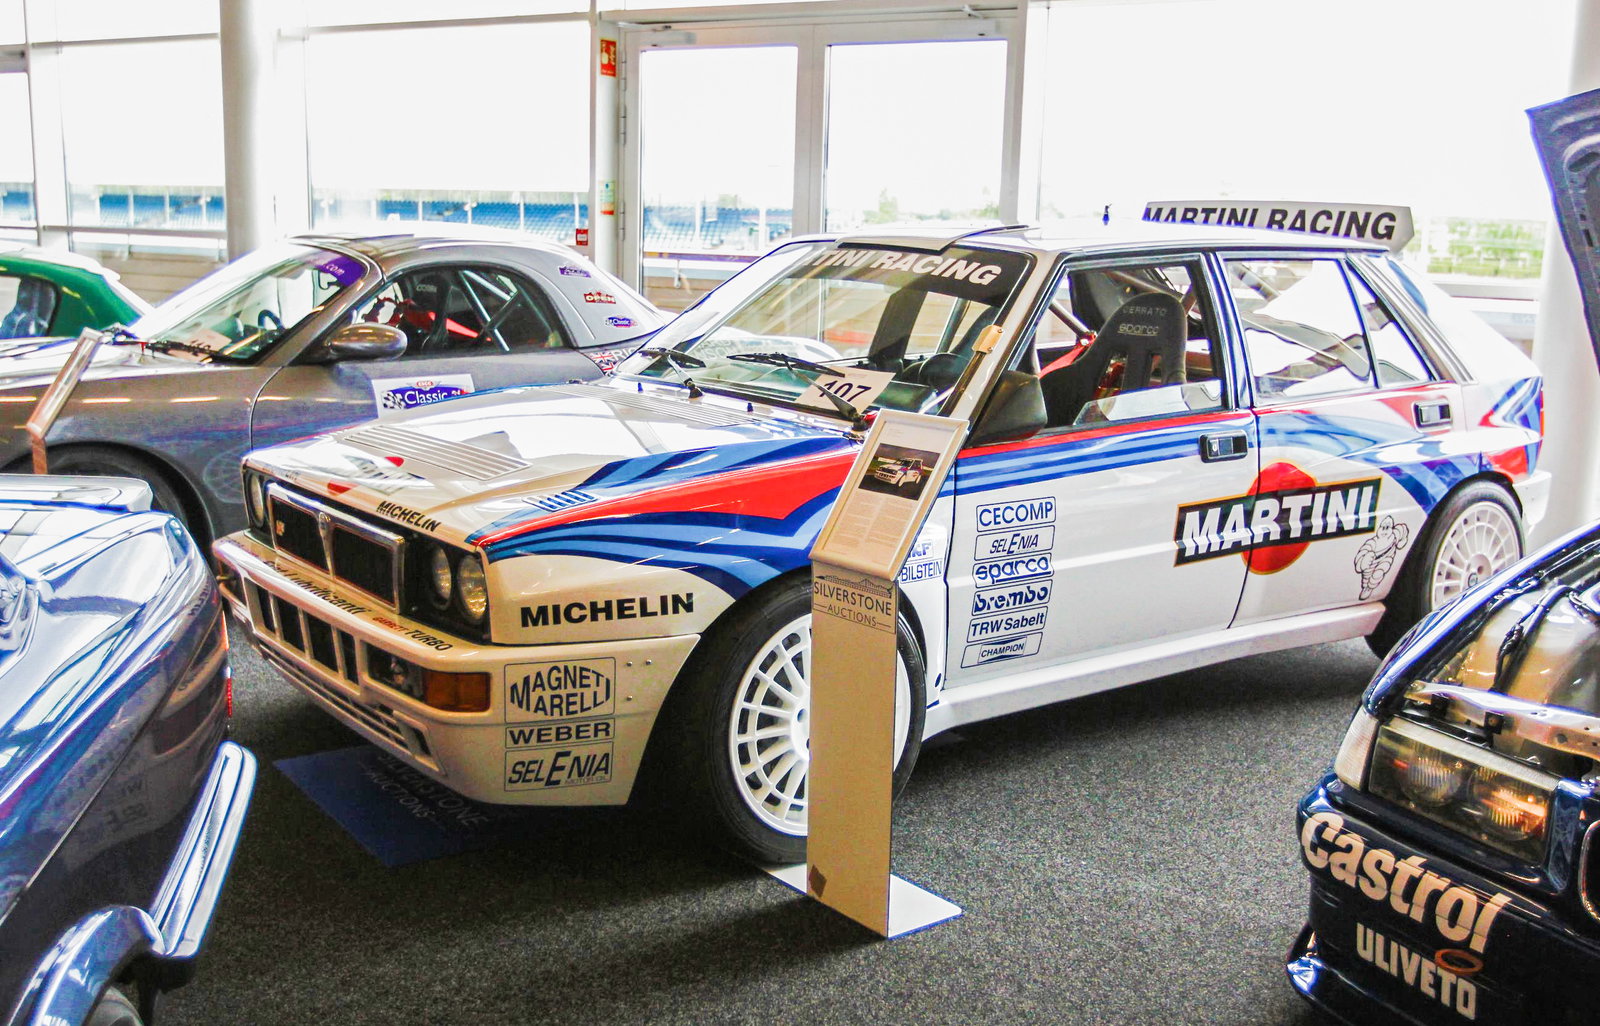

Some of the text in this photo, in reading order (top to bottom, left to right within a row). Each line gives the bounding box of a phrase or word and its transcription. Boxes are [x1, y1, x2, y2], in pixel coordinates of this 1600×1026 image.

[1266, 208, 1397, 241] RACING
[868, 251, 1002, 286] RACING
[404, 390, 448, 404] Classic
[819, 380, 872, 402] 107
[376, 500, 441, 532] MICHELIN
[979, 502, 1053, 527] CECOMP
[1182, 485, 1374, 557] MARTINI
[989, 533, 1039, 555] SELENIA
[901, 560, 943, 582] BILSTEIN
[975, 556, 1050, 584] sparco
[520, 592, 694, 628] MICHELIN
[813, 581, 892, 616] SILVERSTONE
[974, 585, 1049, 613] brembo
[826, 603, 878, 627] AUCTIONS
[971, 612, 1045, 638] TRW Sabelt
[405, 629, 453, 651] TURBO
[981, 643, 1025, 659] CHAMPION
[508, 722, 611, 745] WEBER
[508, 750, 610, 787] SELENIA
[1301, 811, 1513, 954] Castrol
[1356, 922, 1477, 1021] ULIVETO
